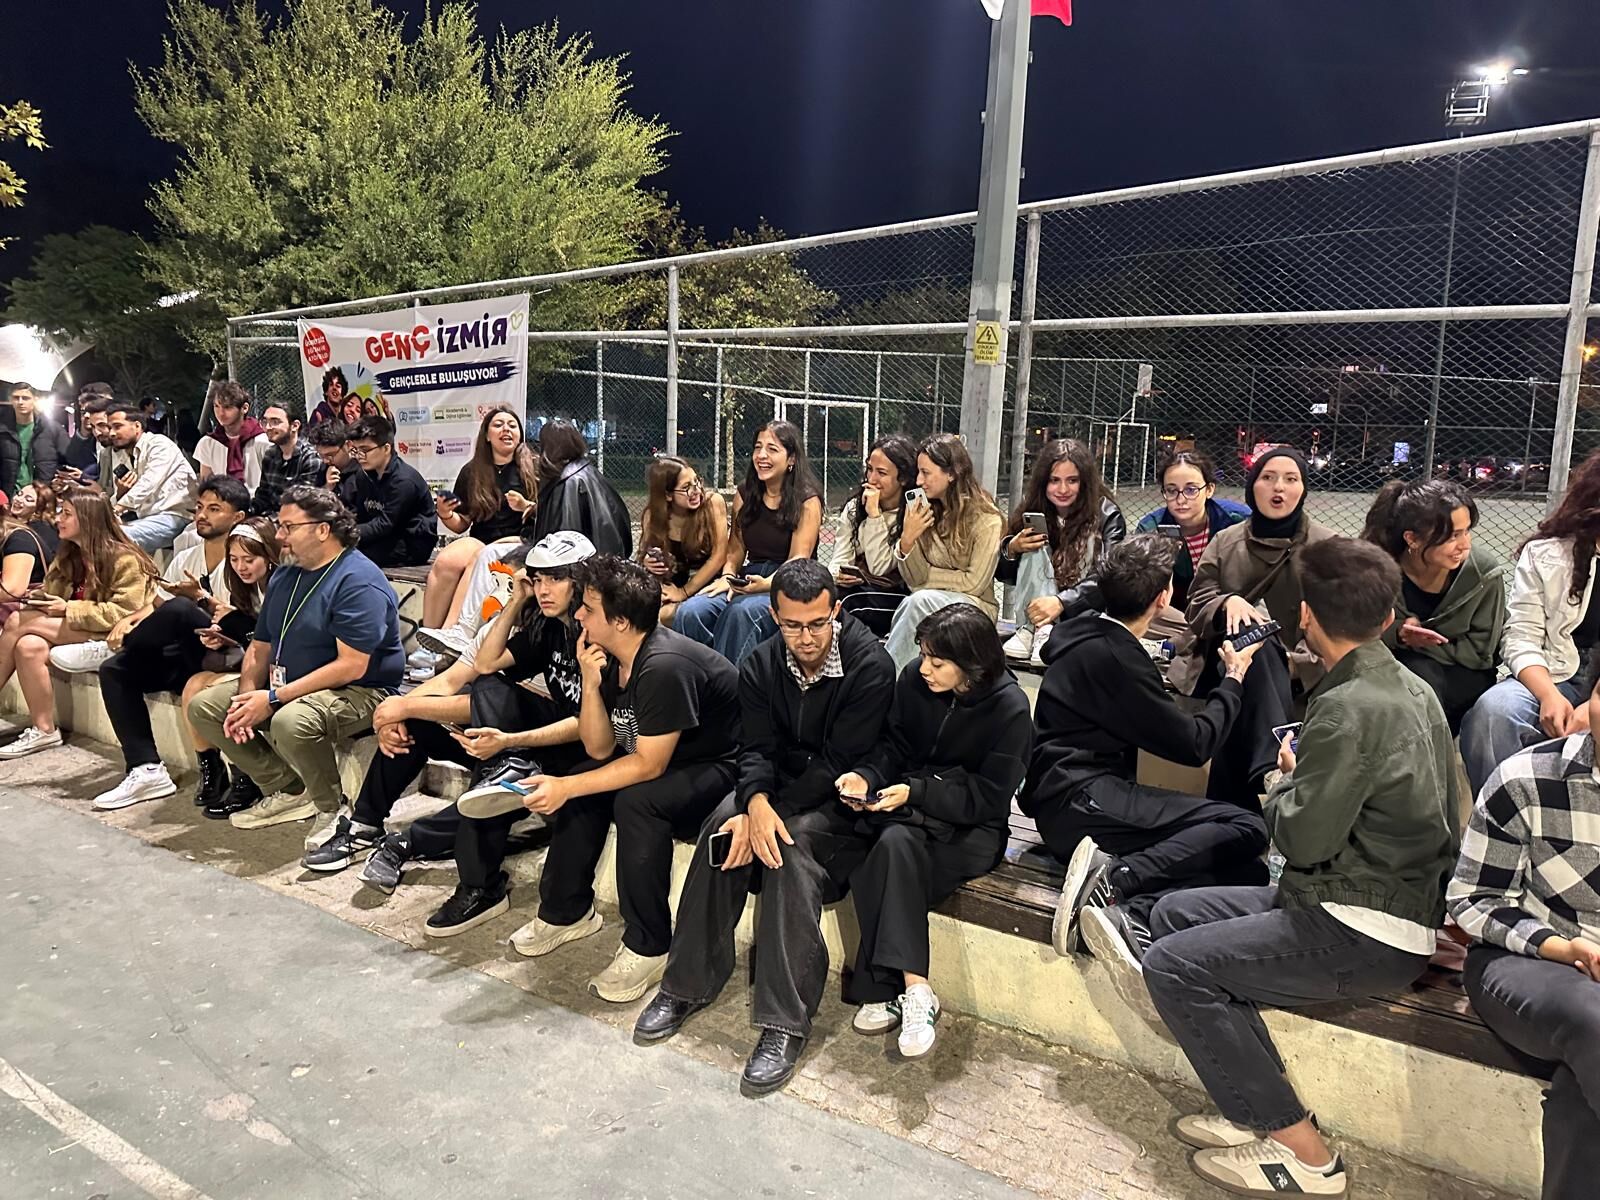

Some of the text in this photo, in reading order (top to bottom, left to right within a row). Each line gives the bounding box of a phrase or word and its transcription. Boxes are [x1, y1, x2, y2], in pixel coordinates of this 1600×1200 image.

[365, 325, 431, 363] GENÇ
[389, 366, 499, 390] GENÇLERLE BULUŞUYOR!
